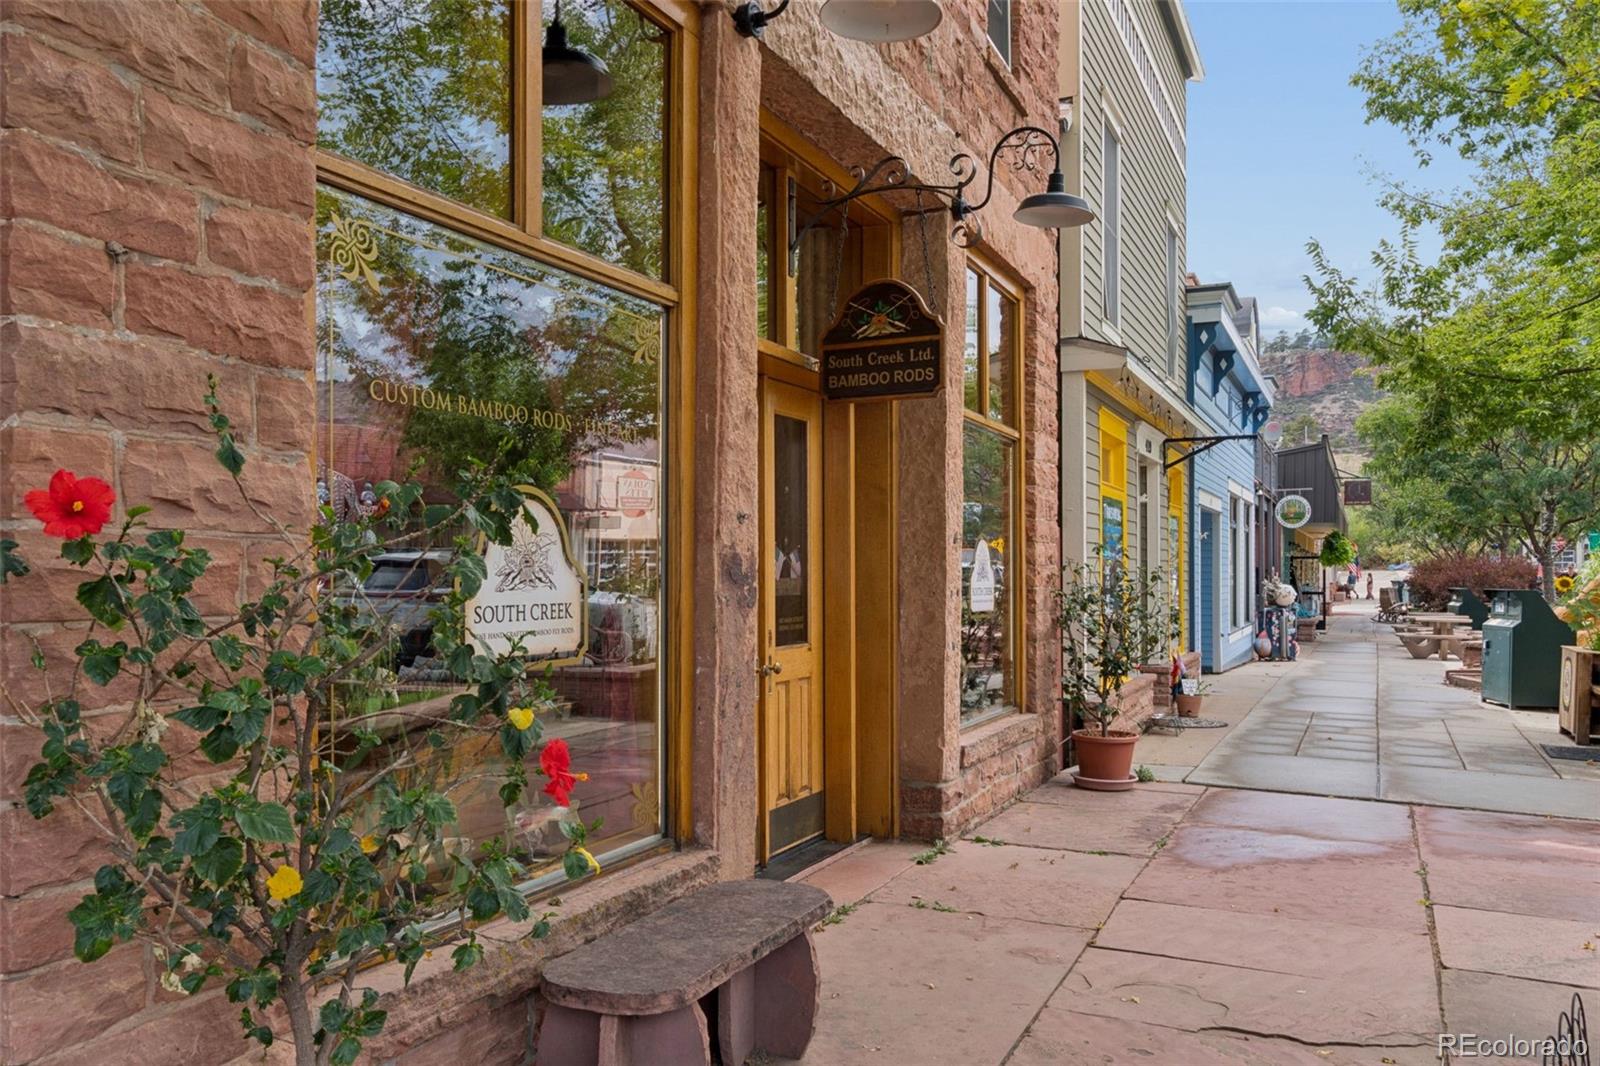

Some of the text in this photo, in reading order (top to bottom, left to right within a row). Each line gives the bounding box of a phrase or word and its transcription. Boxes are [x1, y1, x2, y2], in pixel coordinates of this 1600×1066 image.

[829, 347, 935, 369] South Creek Ltd.
[828, 367, 935, 389] BAMBOO RODS
[369, 379, 452, 411] CUSTOM
[457, 394, 529, 424] BAMBOO
[532, 408, 573, 433] RODS
[473, 602, 573, 624] SOUTH CREEK
